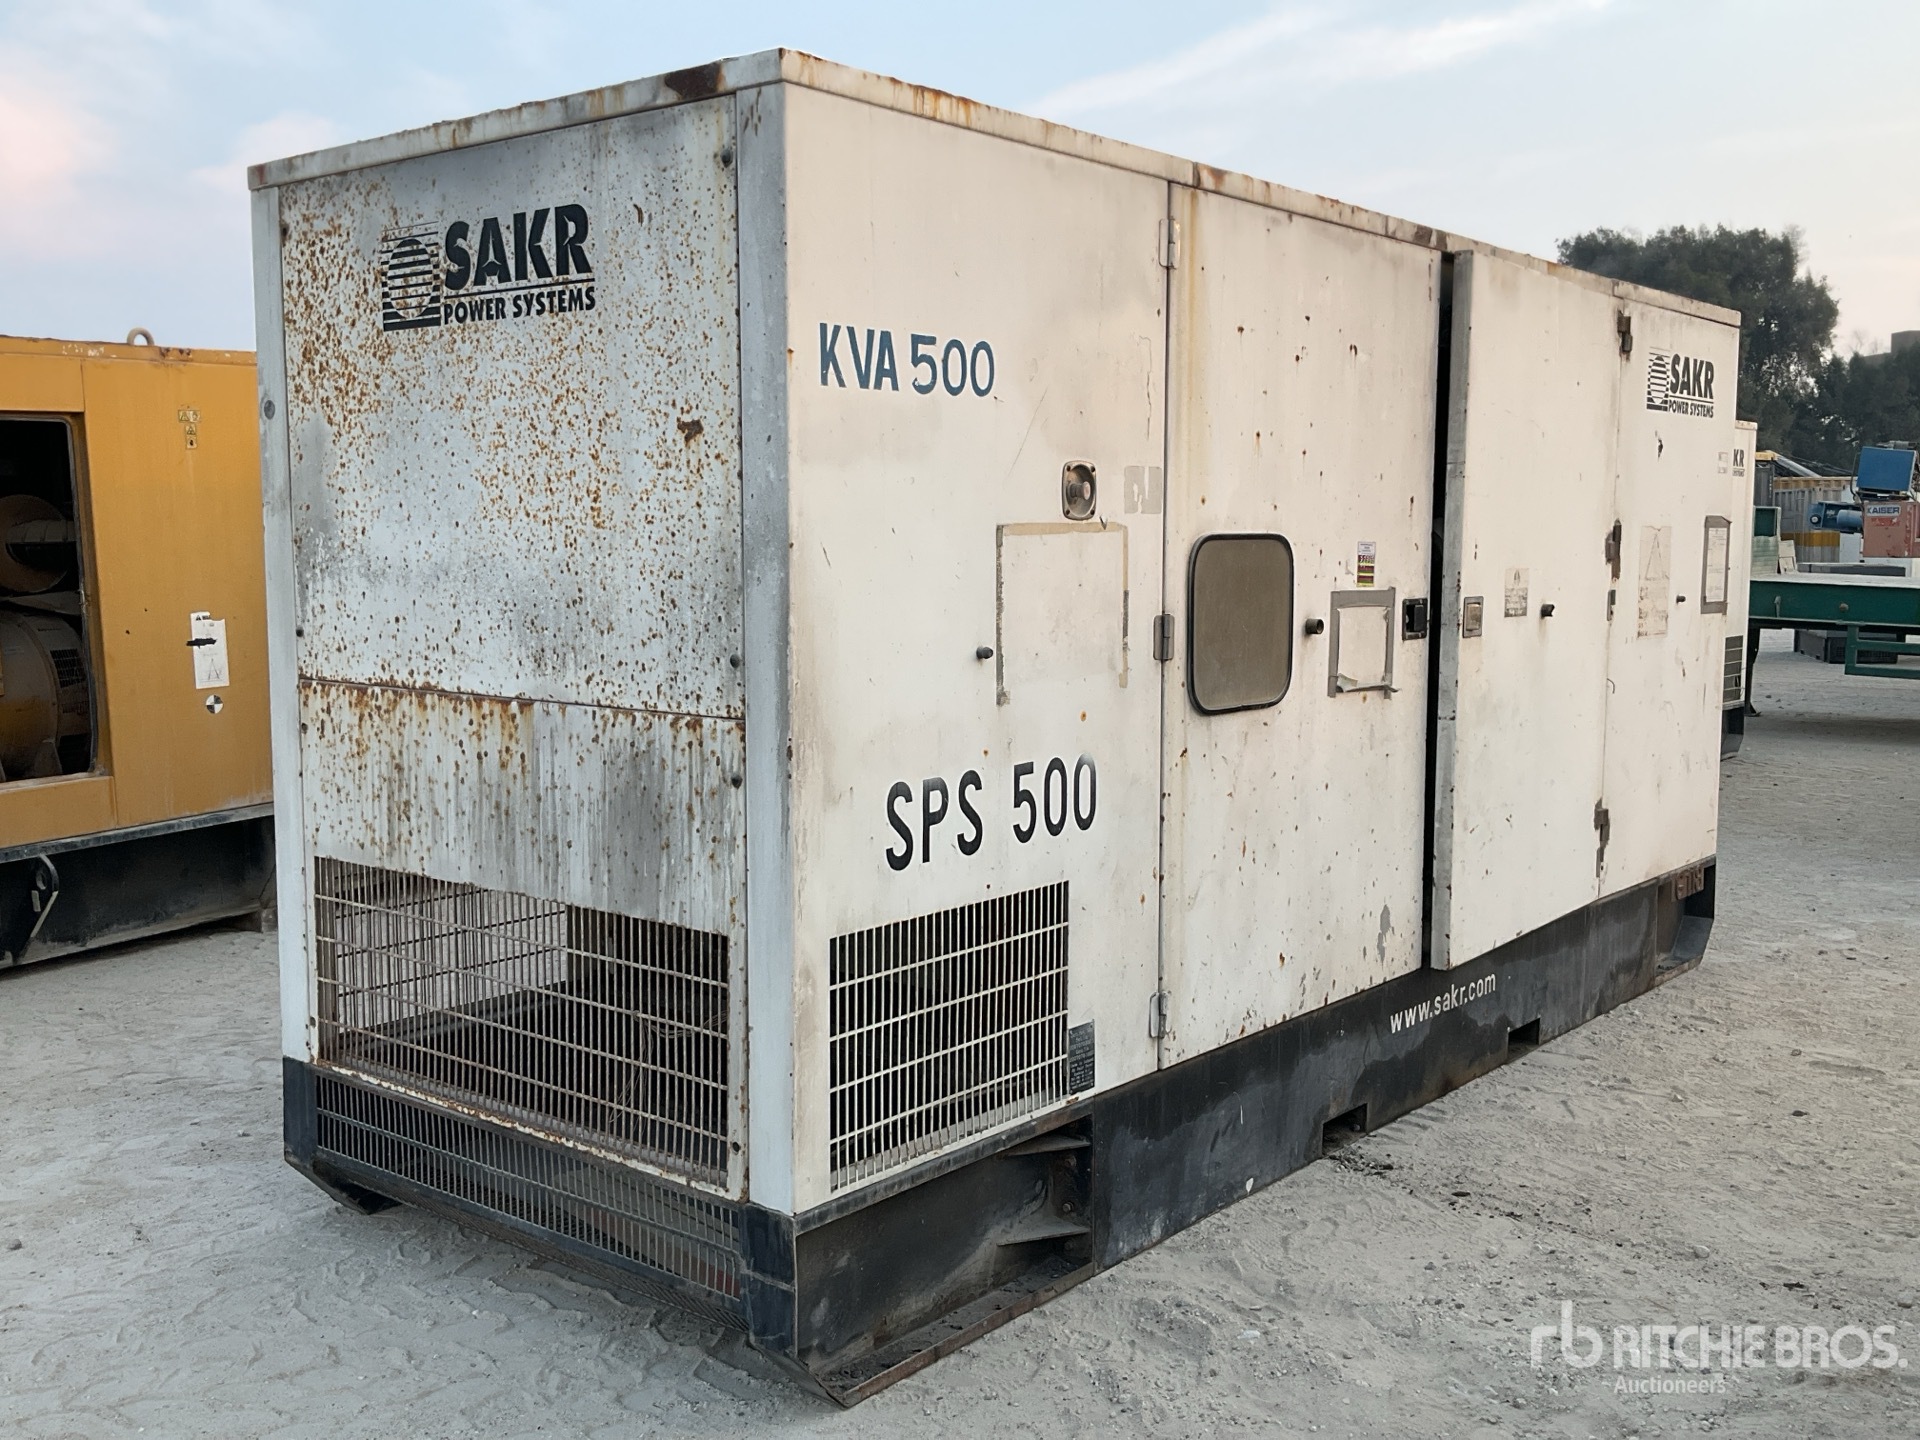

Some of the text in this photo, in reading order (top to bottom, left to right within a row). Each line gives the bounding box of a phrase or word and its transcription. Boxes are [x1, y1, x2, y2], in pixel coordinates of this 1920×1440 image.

[444, 204, 593, 290] SAKR
[443, 287, 596, 325] POWER SYSTEMS
[819, 322, 995, 397] KVA 500
[1669, 353, 1714, 399] SAKR
[1668, 400, 1714, 419] POWER SYSTEMS
[1733, 449, 1745, 467] KR
[1867, 506, 1900, 514] KAISER
[886, 753, 1097, 871] SPS 500
[1390, 973, 1496, 1034] www.sakr.com
